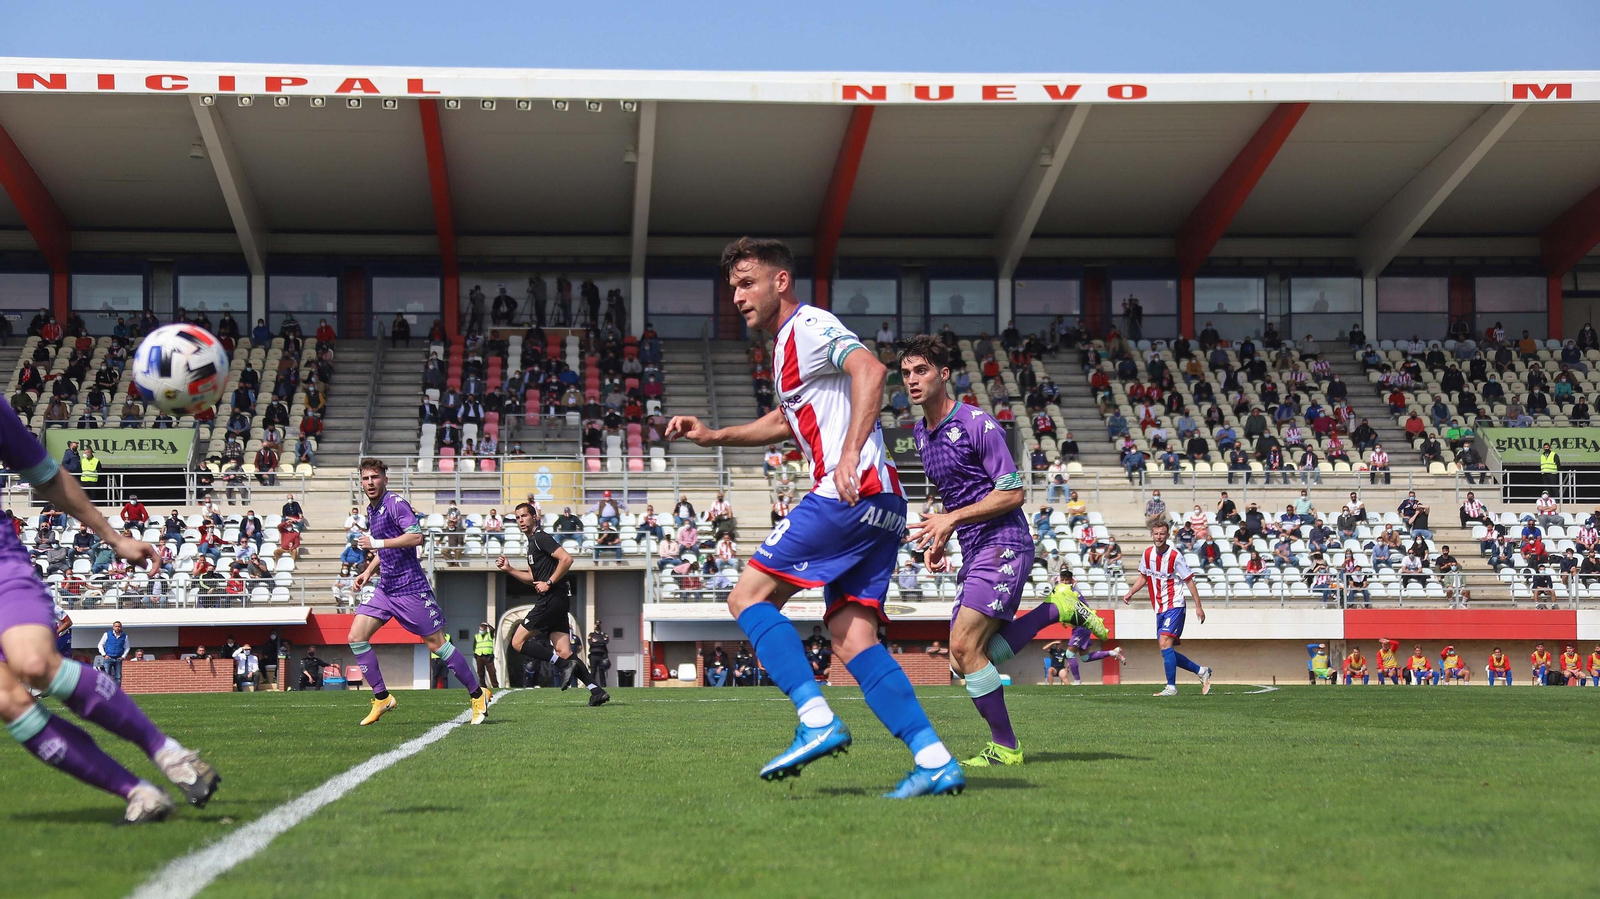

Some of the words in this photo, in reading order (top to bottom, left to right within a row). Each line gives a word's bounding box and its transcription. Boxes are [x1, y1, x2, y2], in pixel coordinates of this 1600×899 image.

[17, 73, 440, 95] NICIPAL
[842, 84, 1148, 101] NUEVO
[1512, 83, 1572, 99] M
[67, 439, 178, 454] RILLAERA
[765, 518, 790, 547] 8
